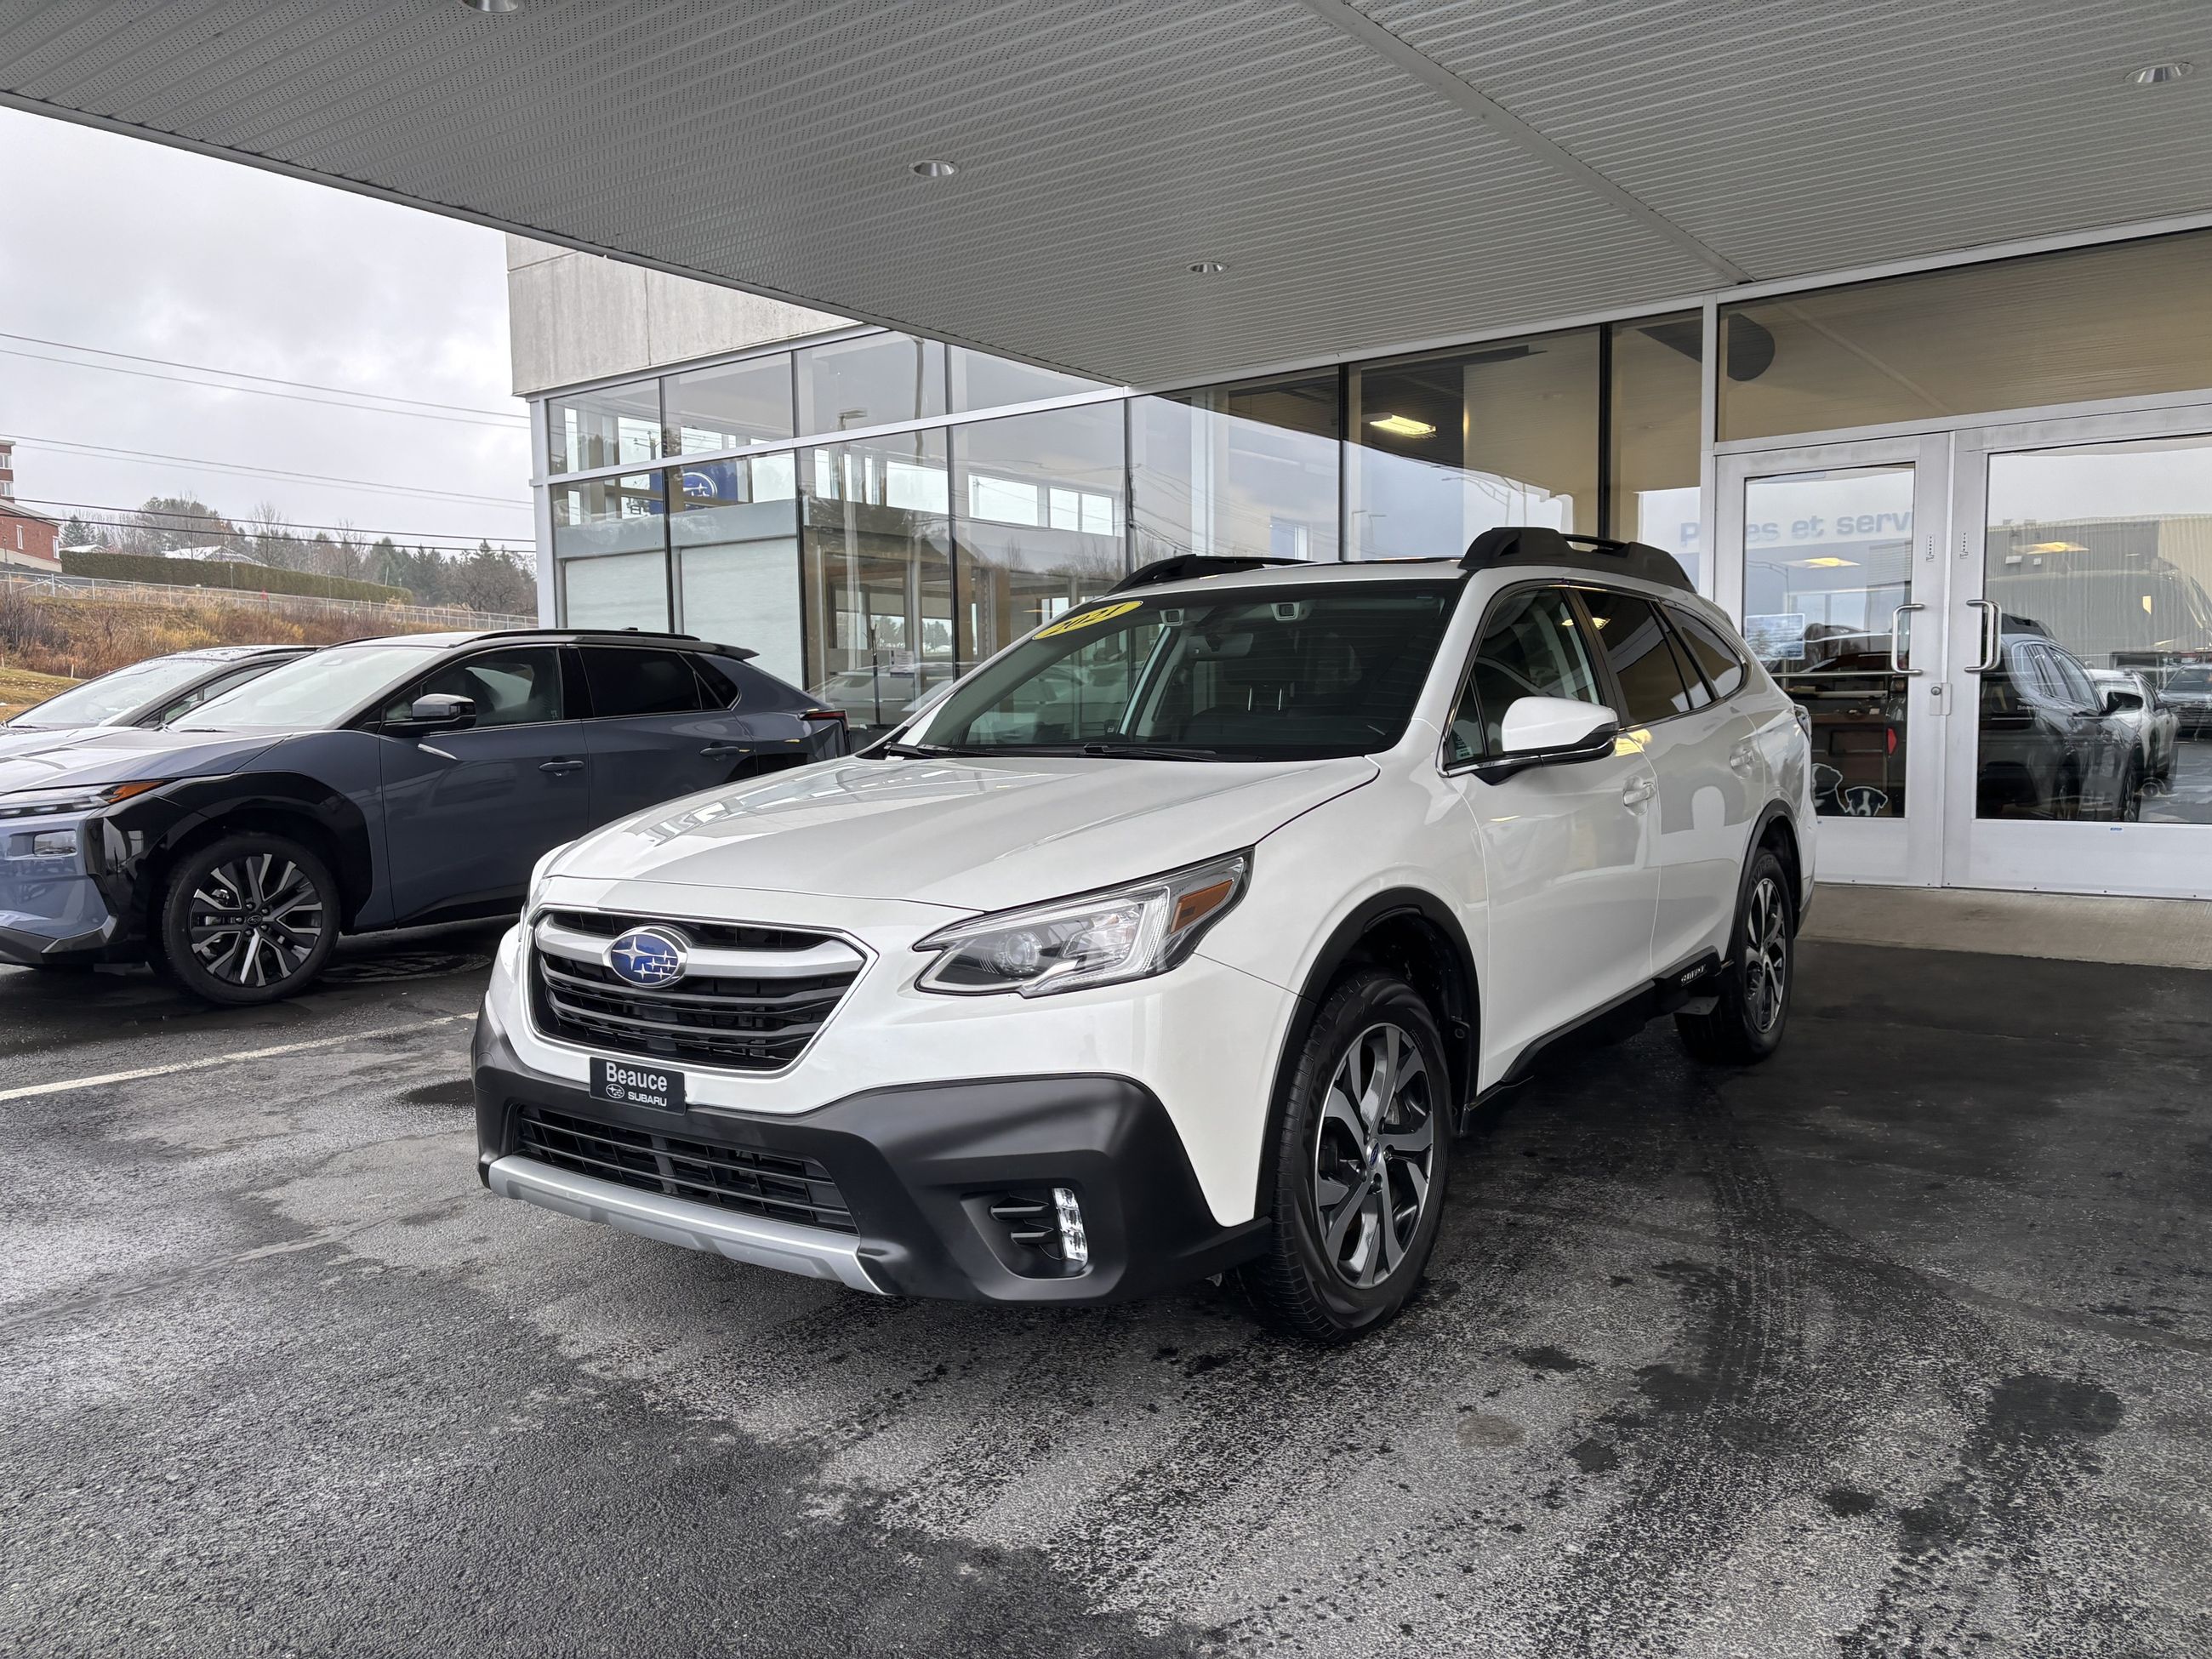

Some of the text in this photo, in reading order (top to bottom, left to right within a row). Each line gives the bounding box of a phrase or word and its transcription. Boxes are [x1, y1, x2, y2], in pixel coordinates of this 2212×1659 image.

[1791, 515, 1824, 539] et
[1836, 511, 1912, 534] serv
[1041, 602, 1127, 636] 2021
[606, 1062, 667, 1092] Beauce
[628, 1092, 667, 1106] SUBARU
